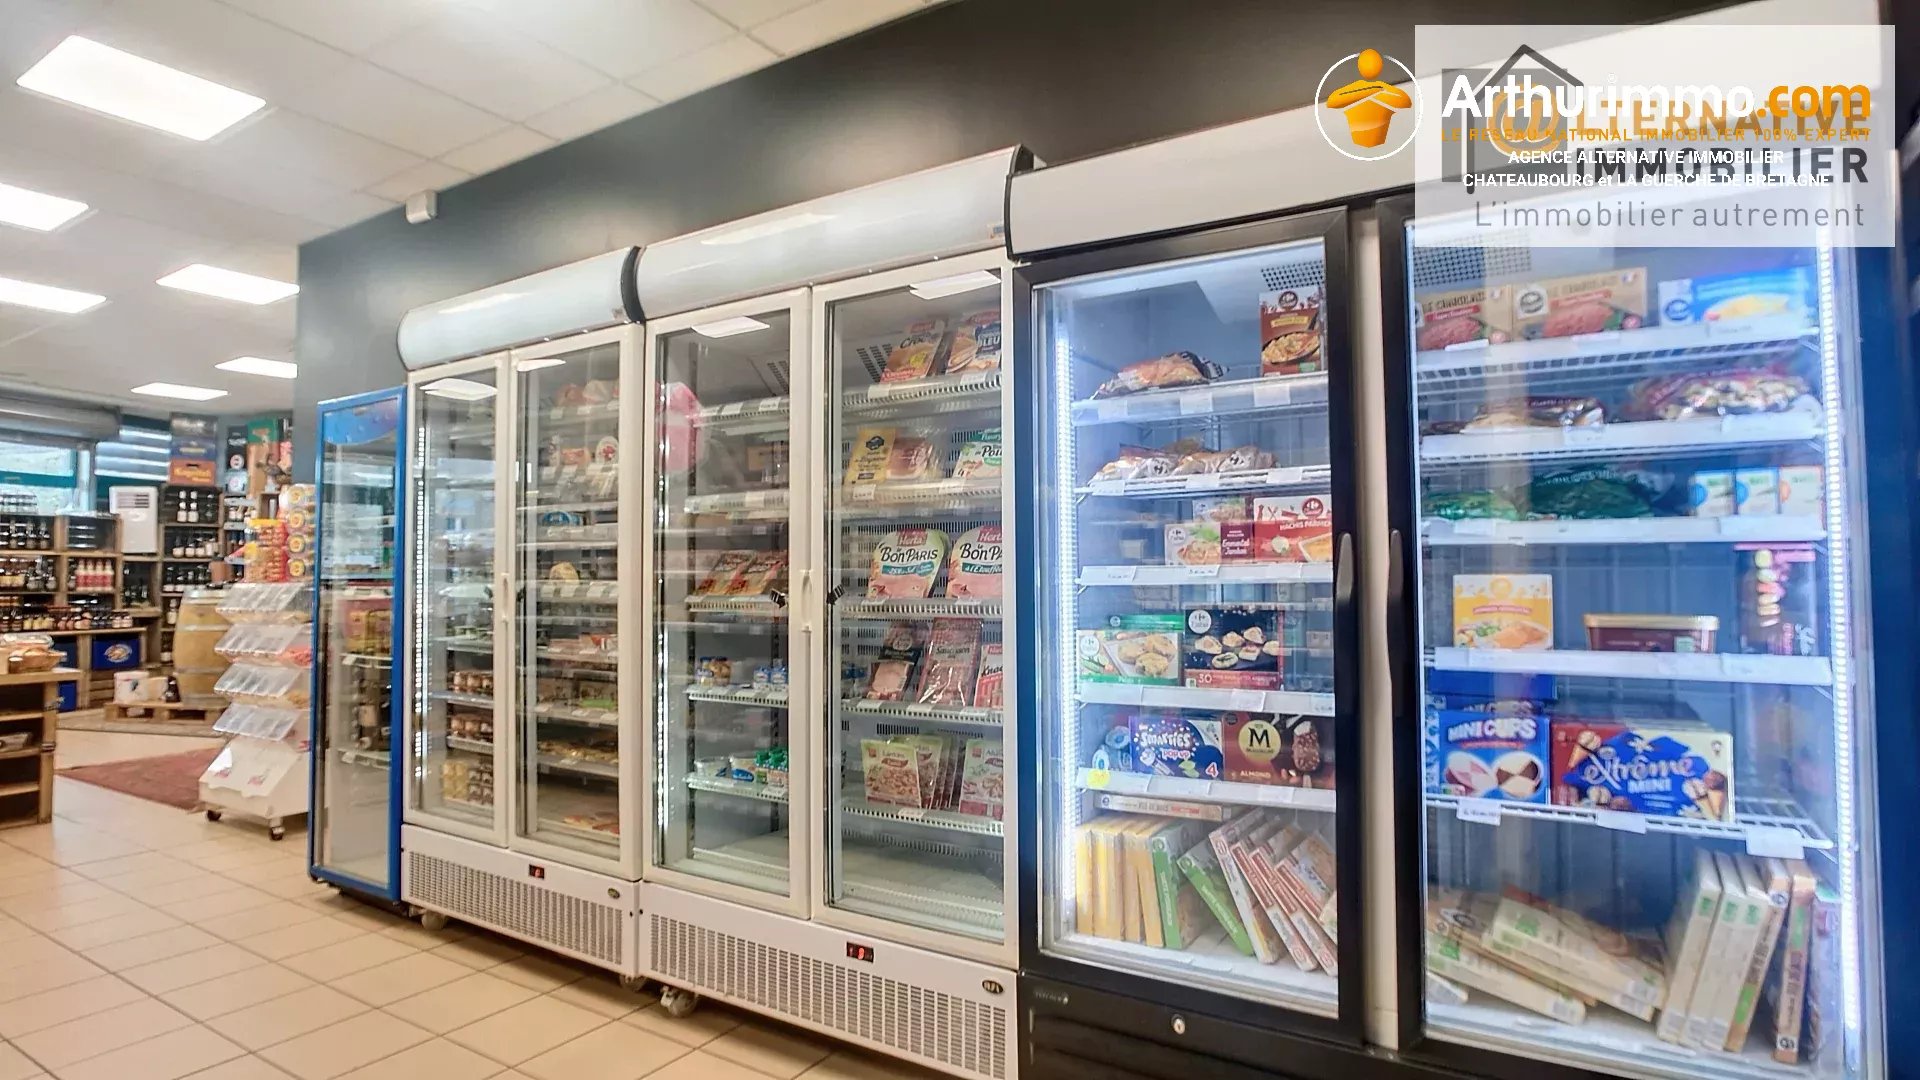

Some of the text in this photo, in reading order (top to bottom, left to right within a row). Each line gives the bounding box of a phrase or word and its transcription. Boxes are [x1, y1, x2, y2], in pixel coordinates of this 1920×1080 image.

[1199, 673, 1213, 684] 30
[1249, 727, 1271, 748] M
[1627, 778, 1672, 794] MINI
